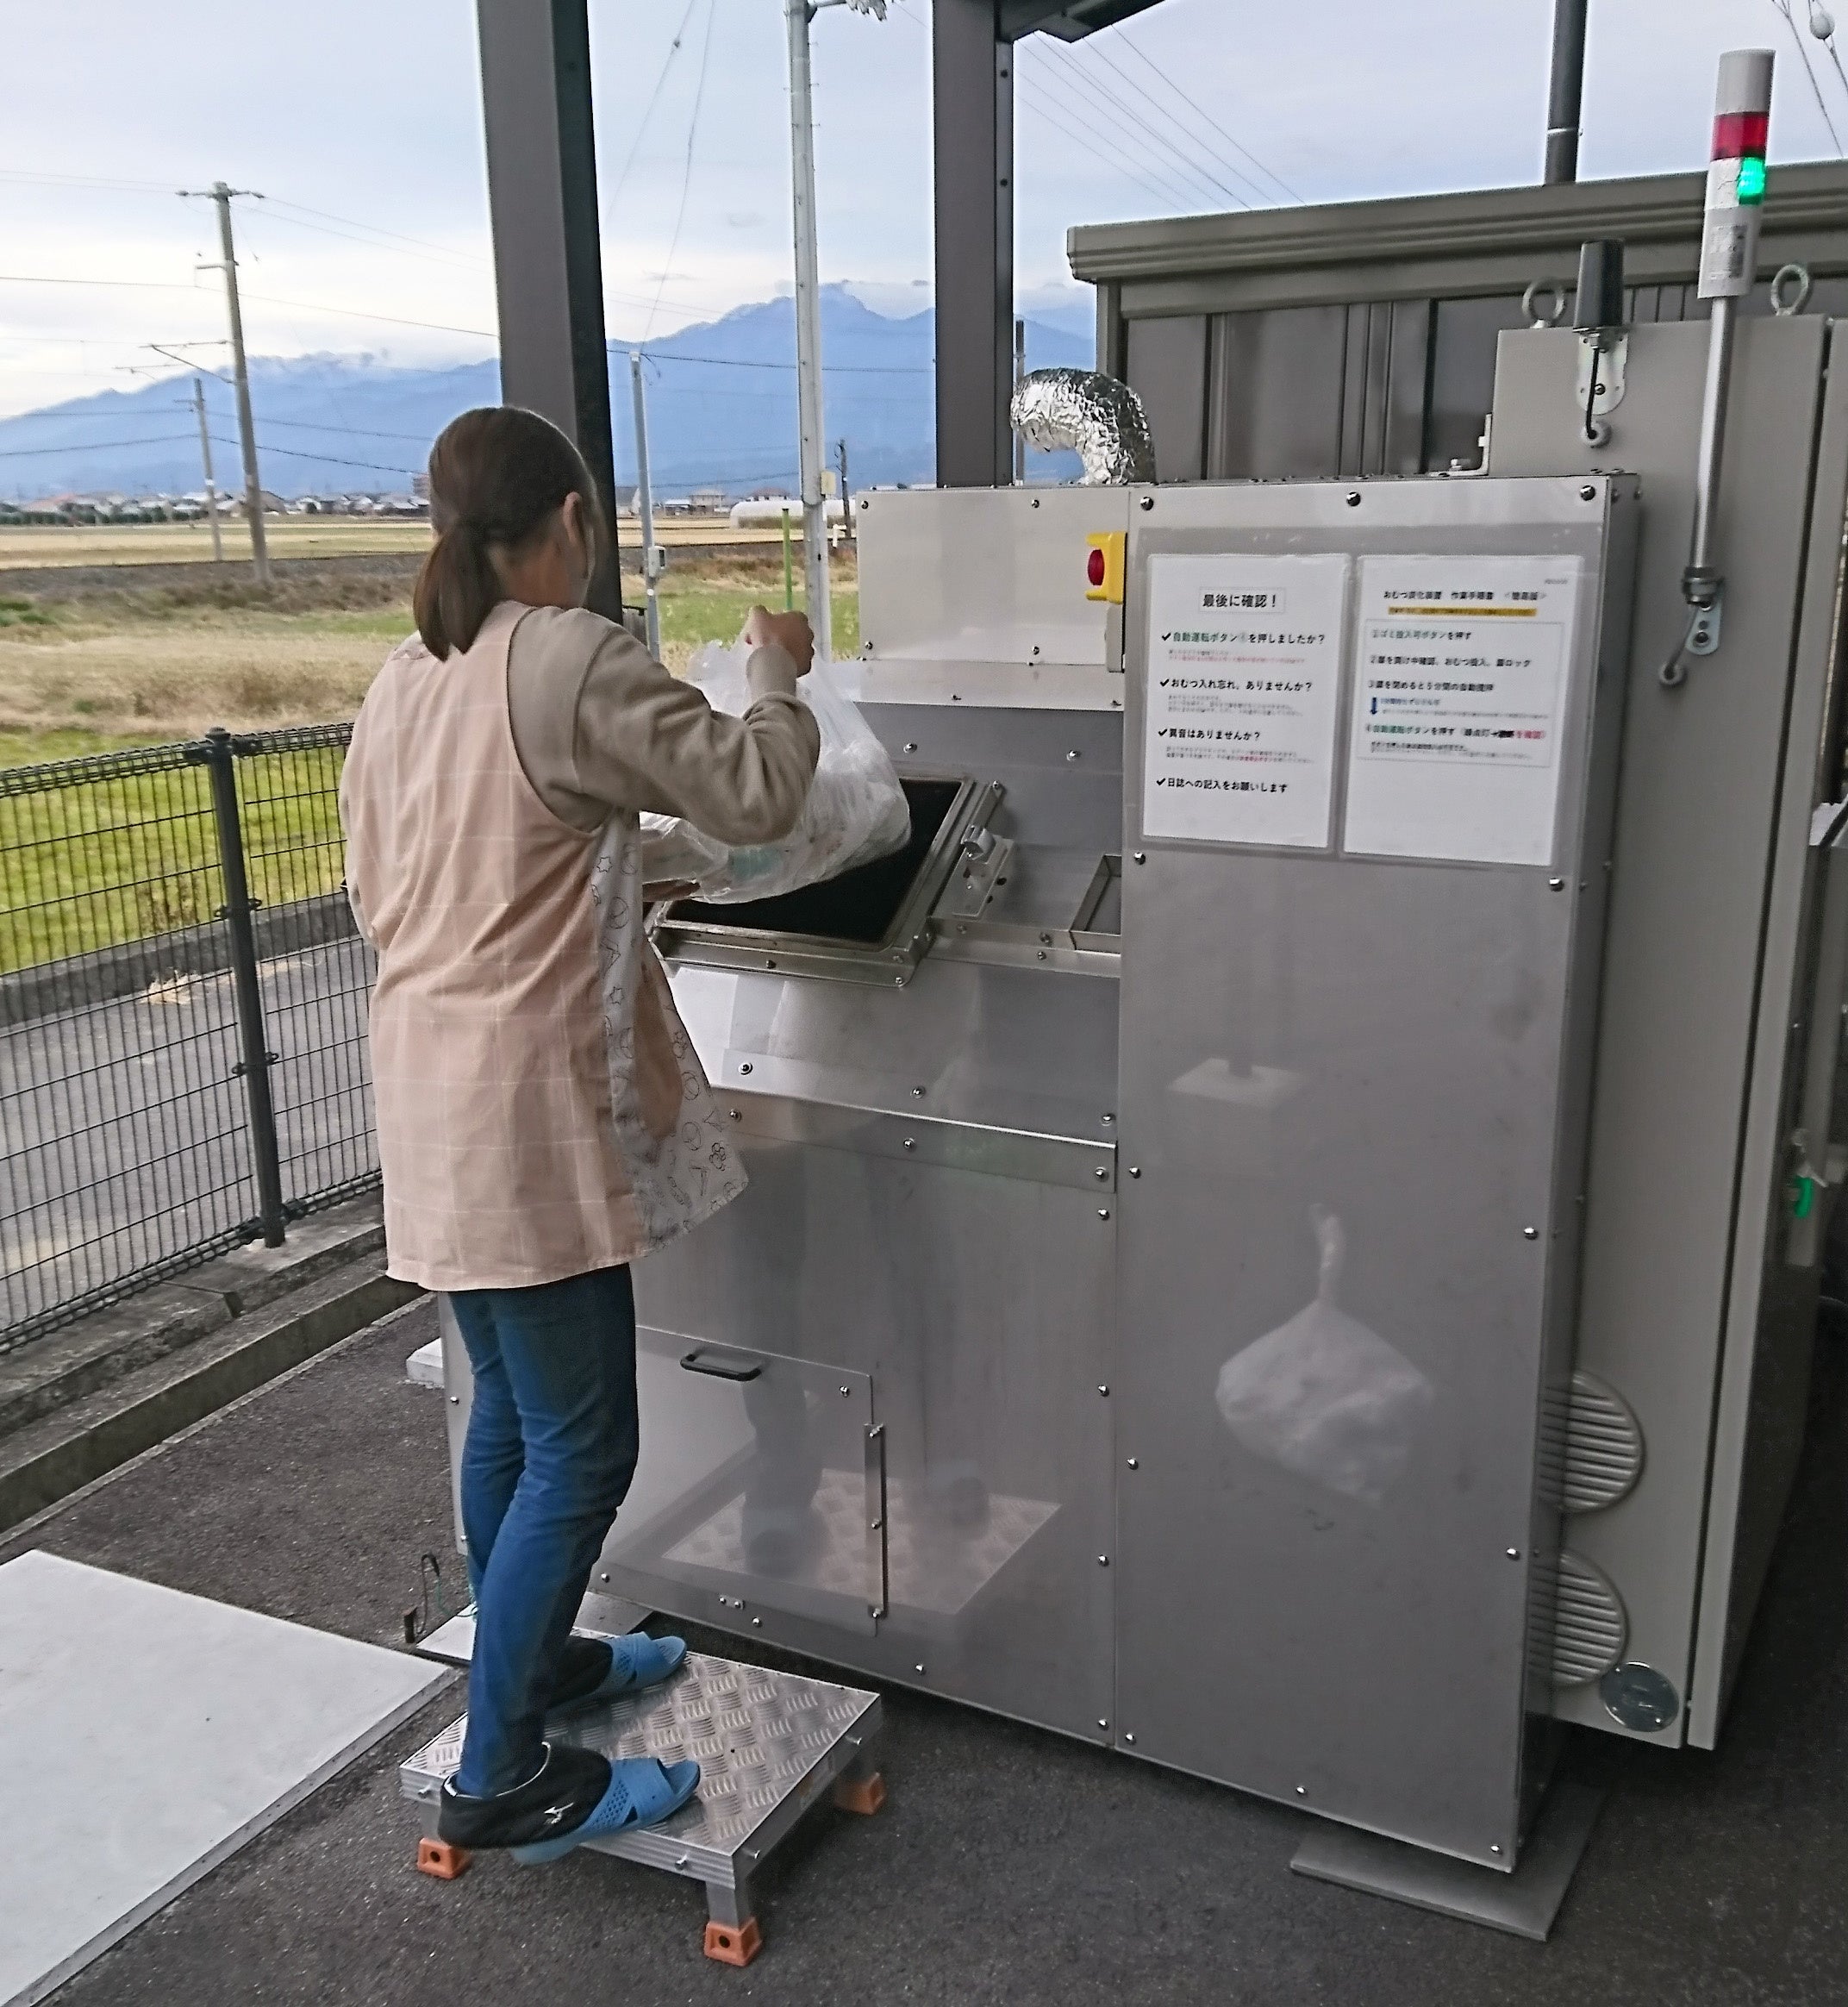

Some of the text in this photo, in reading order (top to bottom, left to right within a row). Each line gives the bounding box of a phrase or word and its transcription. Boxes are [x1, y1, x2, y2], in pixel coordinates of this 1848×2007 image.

[1167, 778, 1288, 793] 日誌への記入をお願いします
